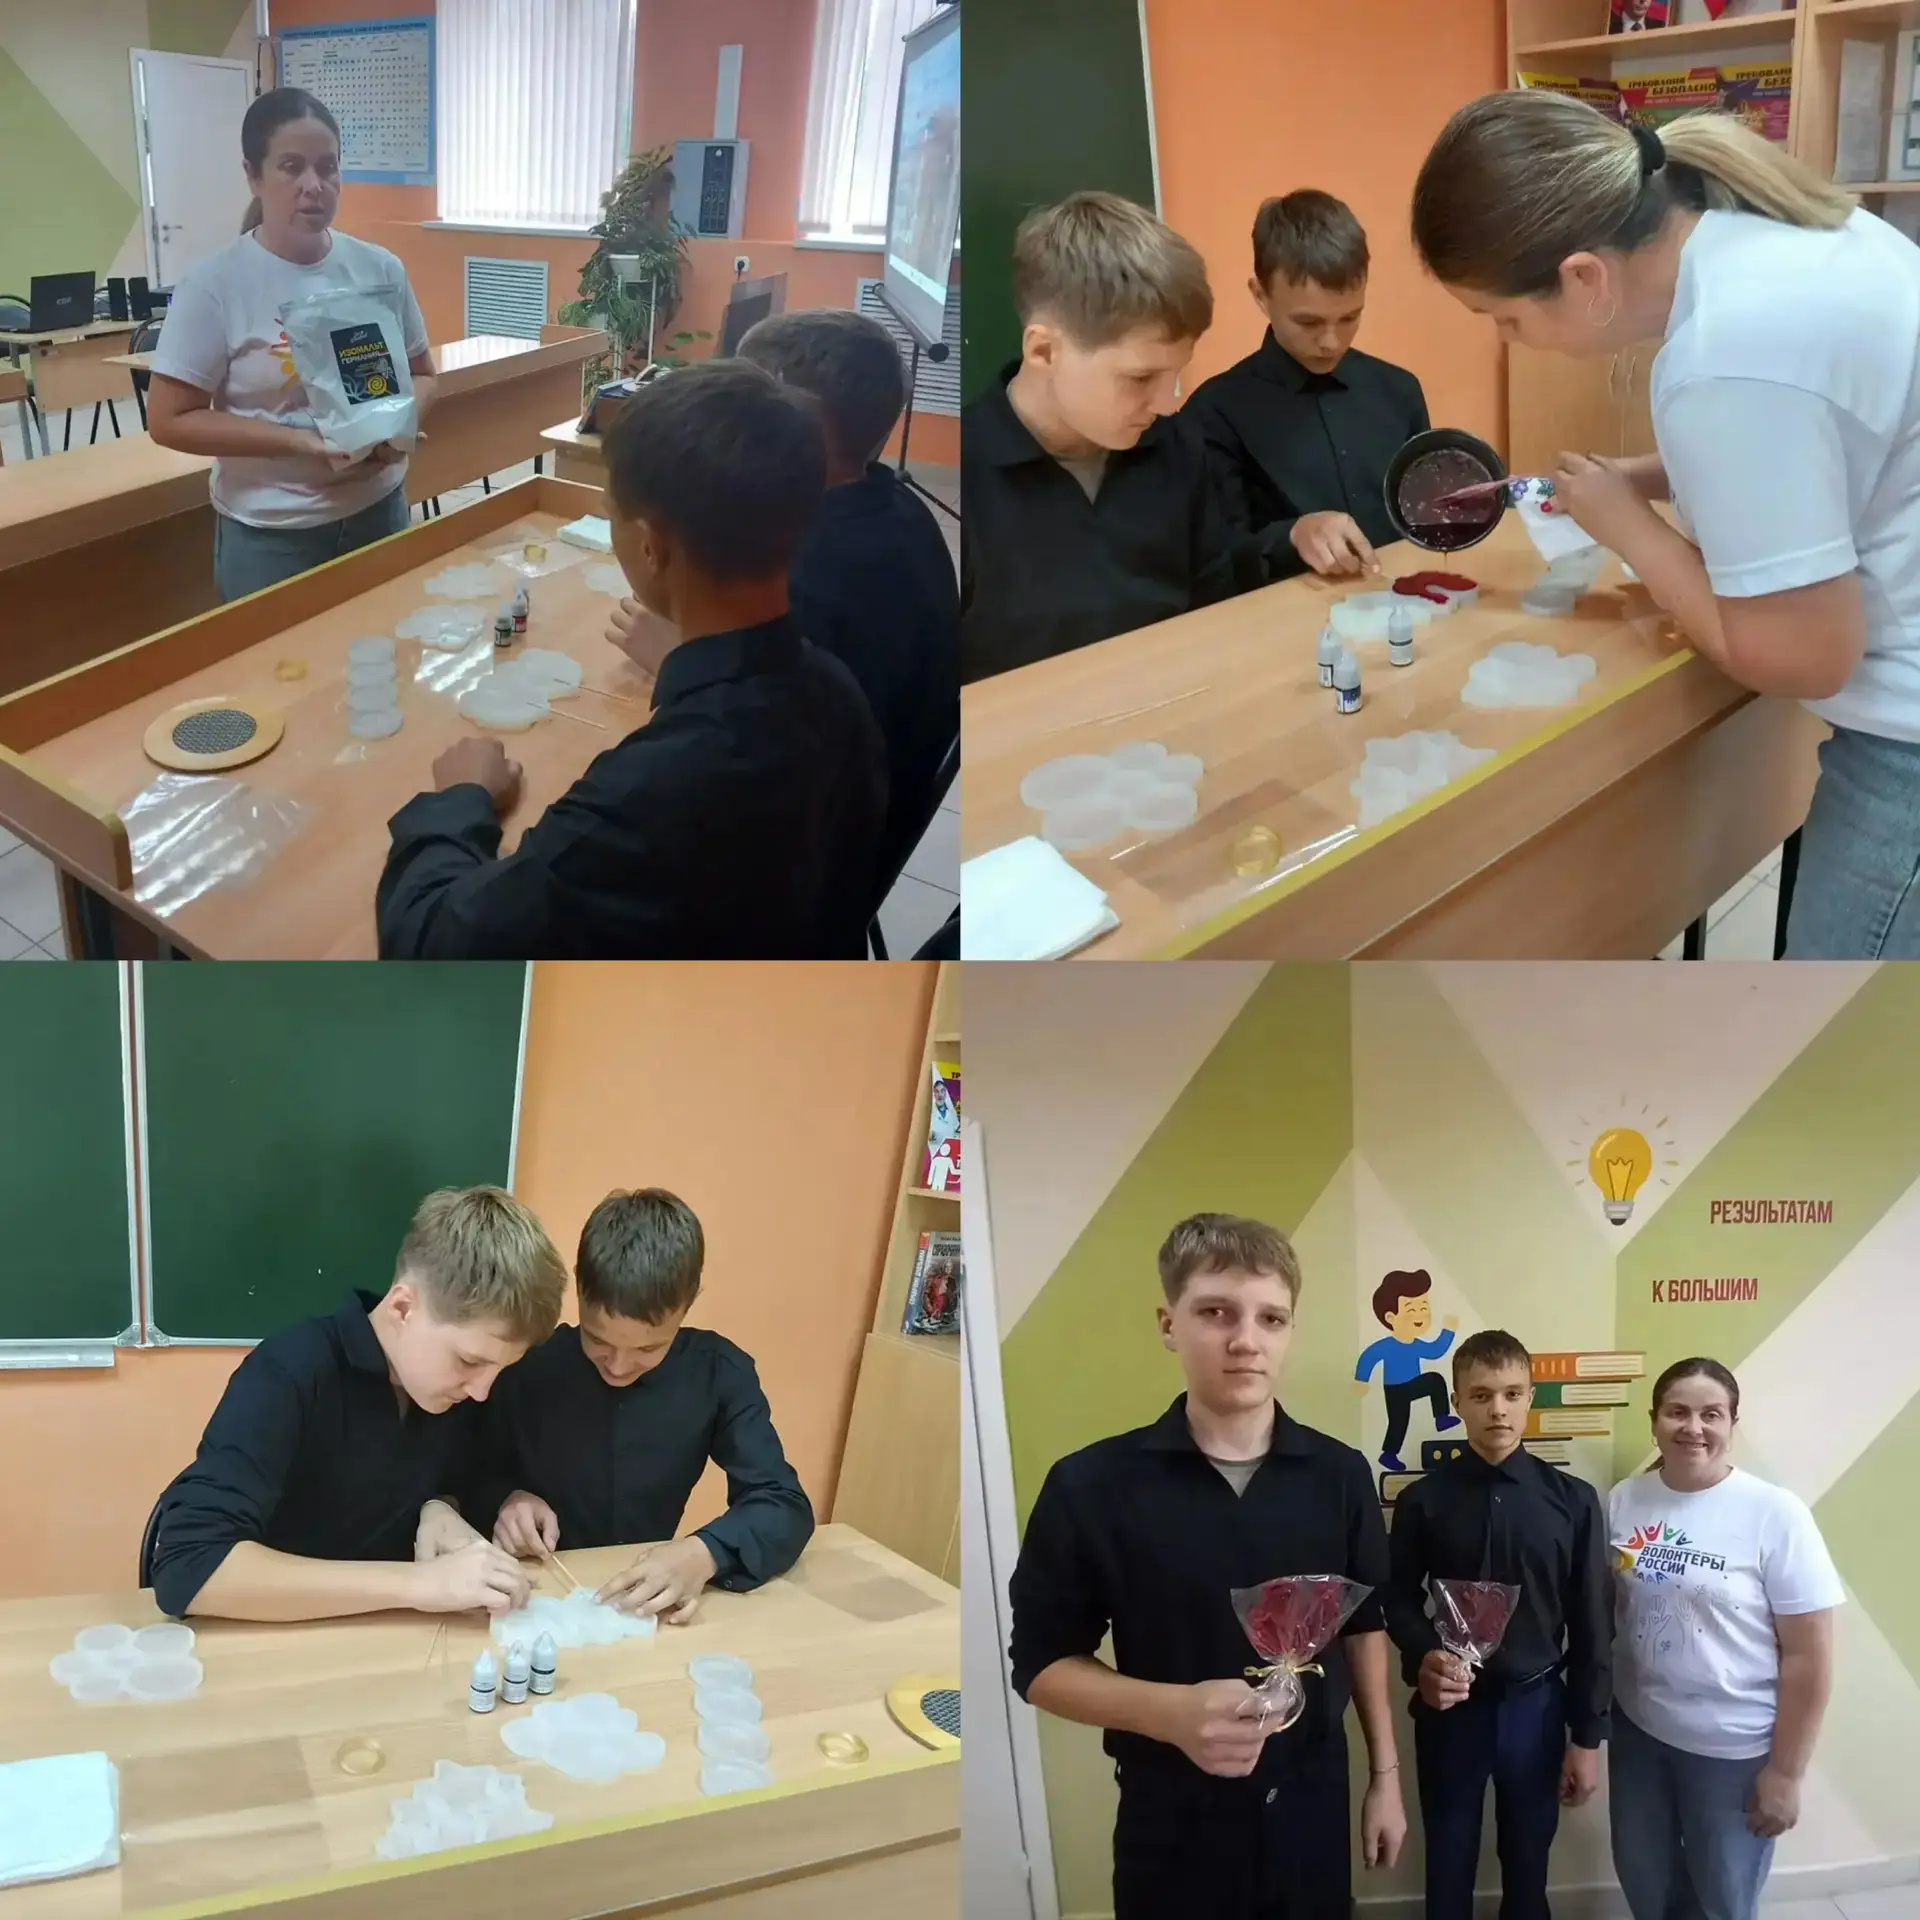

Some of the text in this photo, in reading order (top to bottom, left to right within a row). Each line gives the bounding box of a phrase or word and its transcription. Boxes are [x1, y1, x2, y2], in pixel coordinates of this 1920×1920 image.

[339, 341, 384, 358] ИЗОМАЛЬТ
[1710, 1200, 1833, 1225] РЕЗУЛЬТАТАМ
[1652, 1278, 1758, 1303] К БОЛЬШИМ
[1636, 1556, 1686, 1576] РОССИИ
[1641, 1545, 1725, 1571] ВОЛОНТЕРЫ
